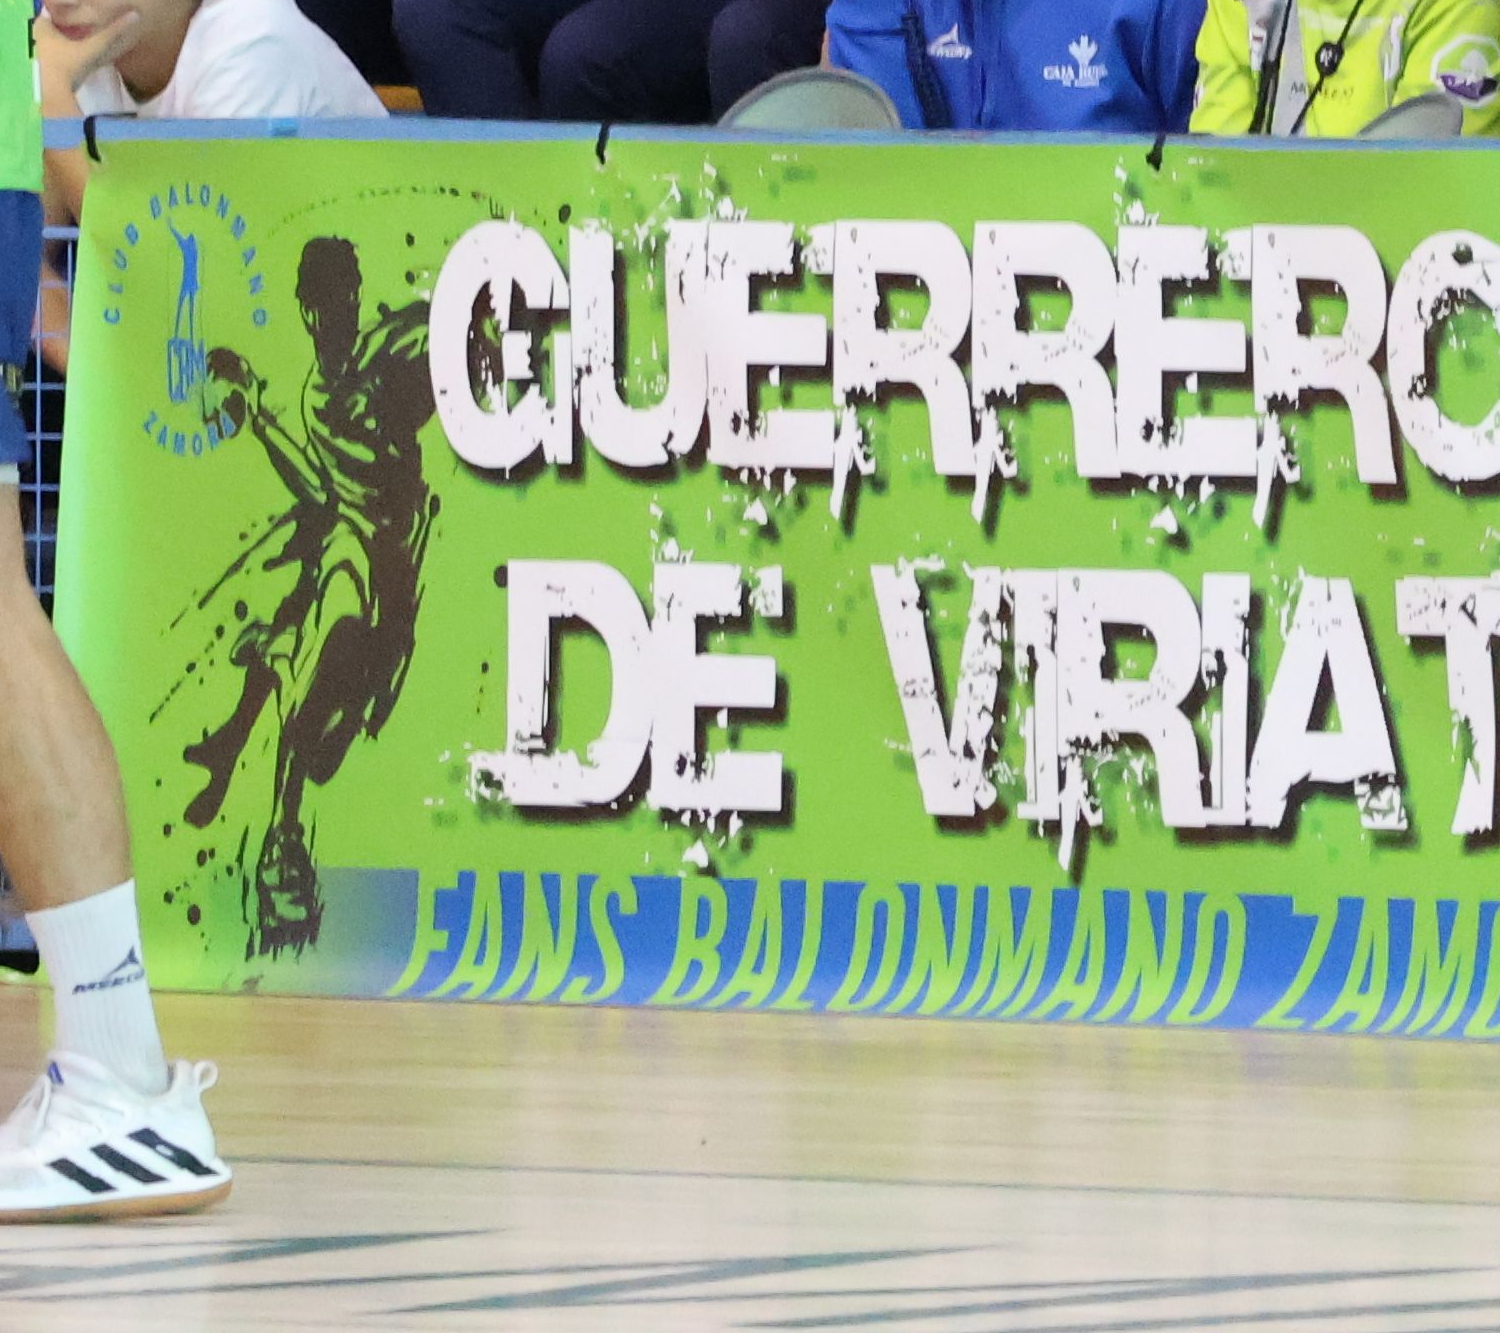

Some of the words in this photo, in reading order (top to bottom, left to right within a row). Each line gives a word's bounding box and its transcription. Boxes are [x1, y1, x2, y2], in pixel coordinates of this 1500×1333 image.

[149, 180, 271, 329] BALONMANO
[143, 412, 237, 459] ZAMORA
[475, 555, 785, 815] DE
[403, 870, 640, 1002] FANS
[657, 876, 1250, 1026] BALONMANO
